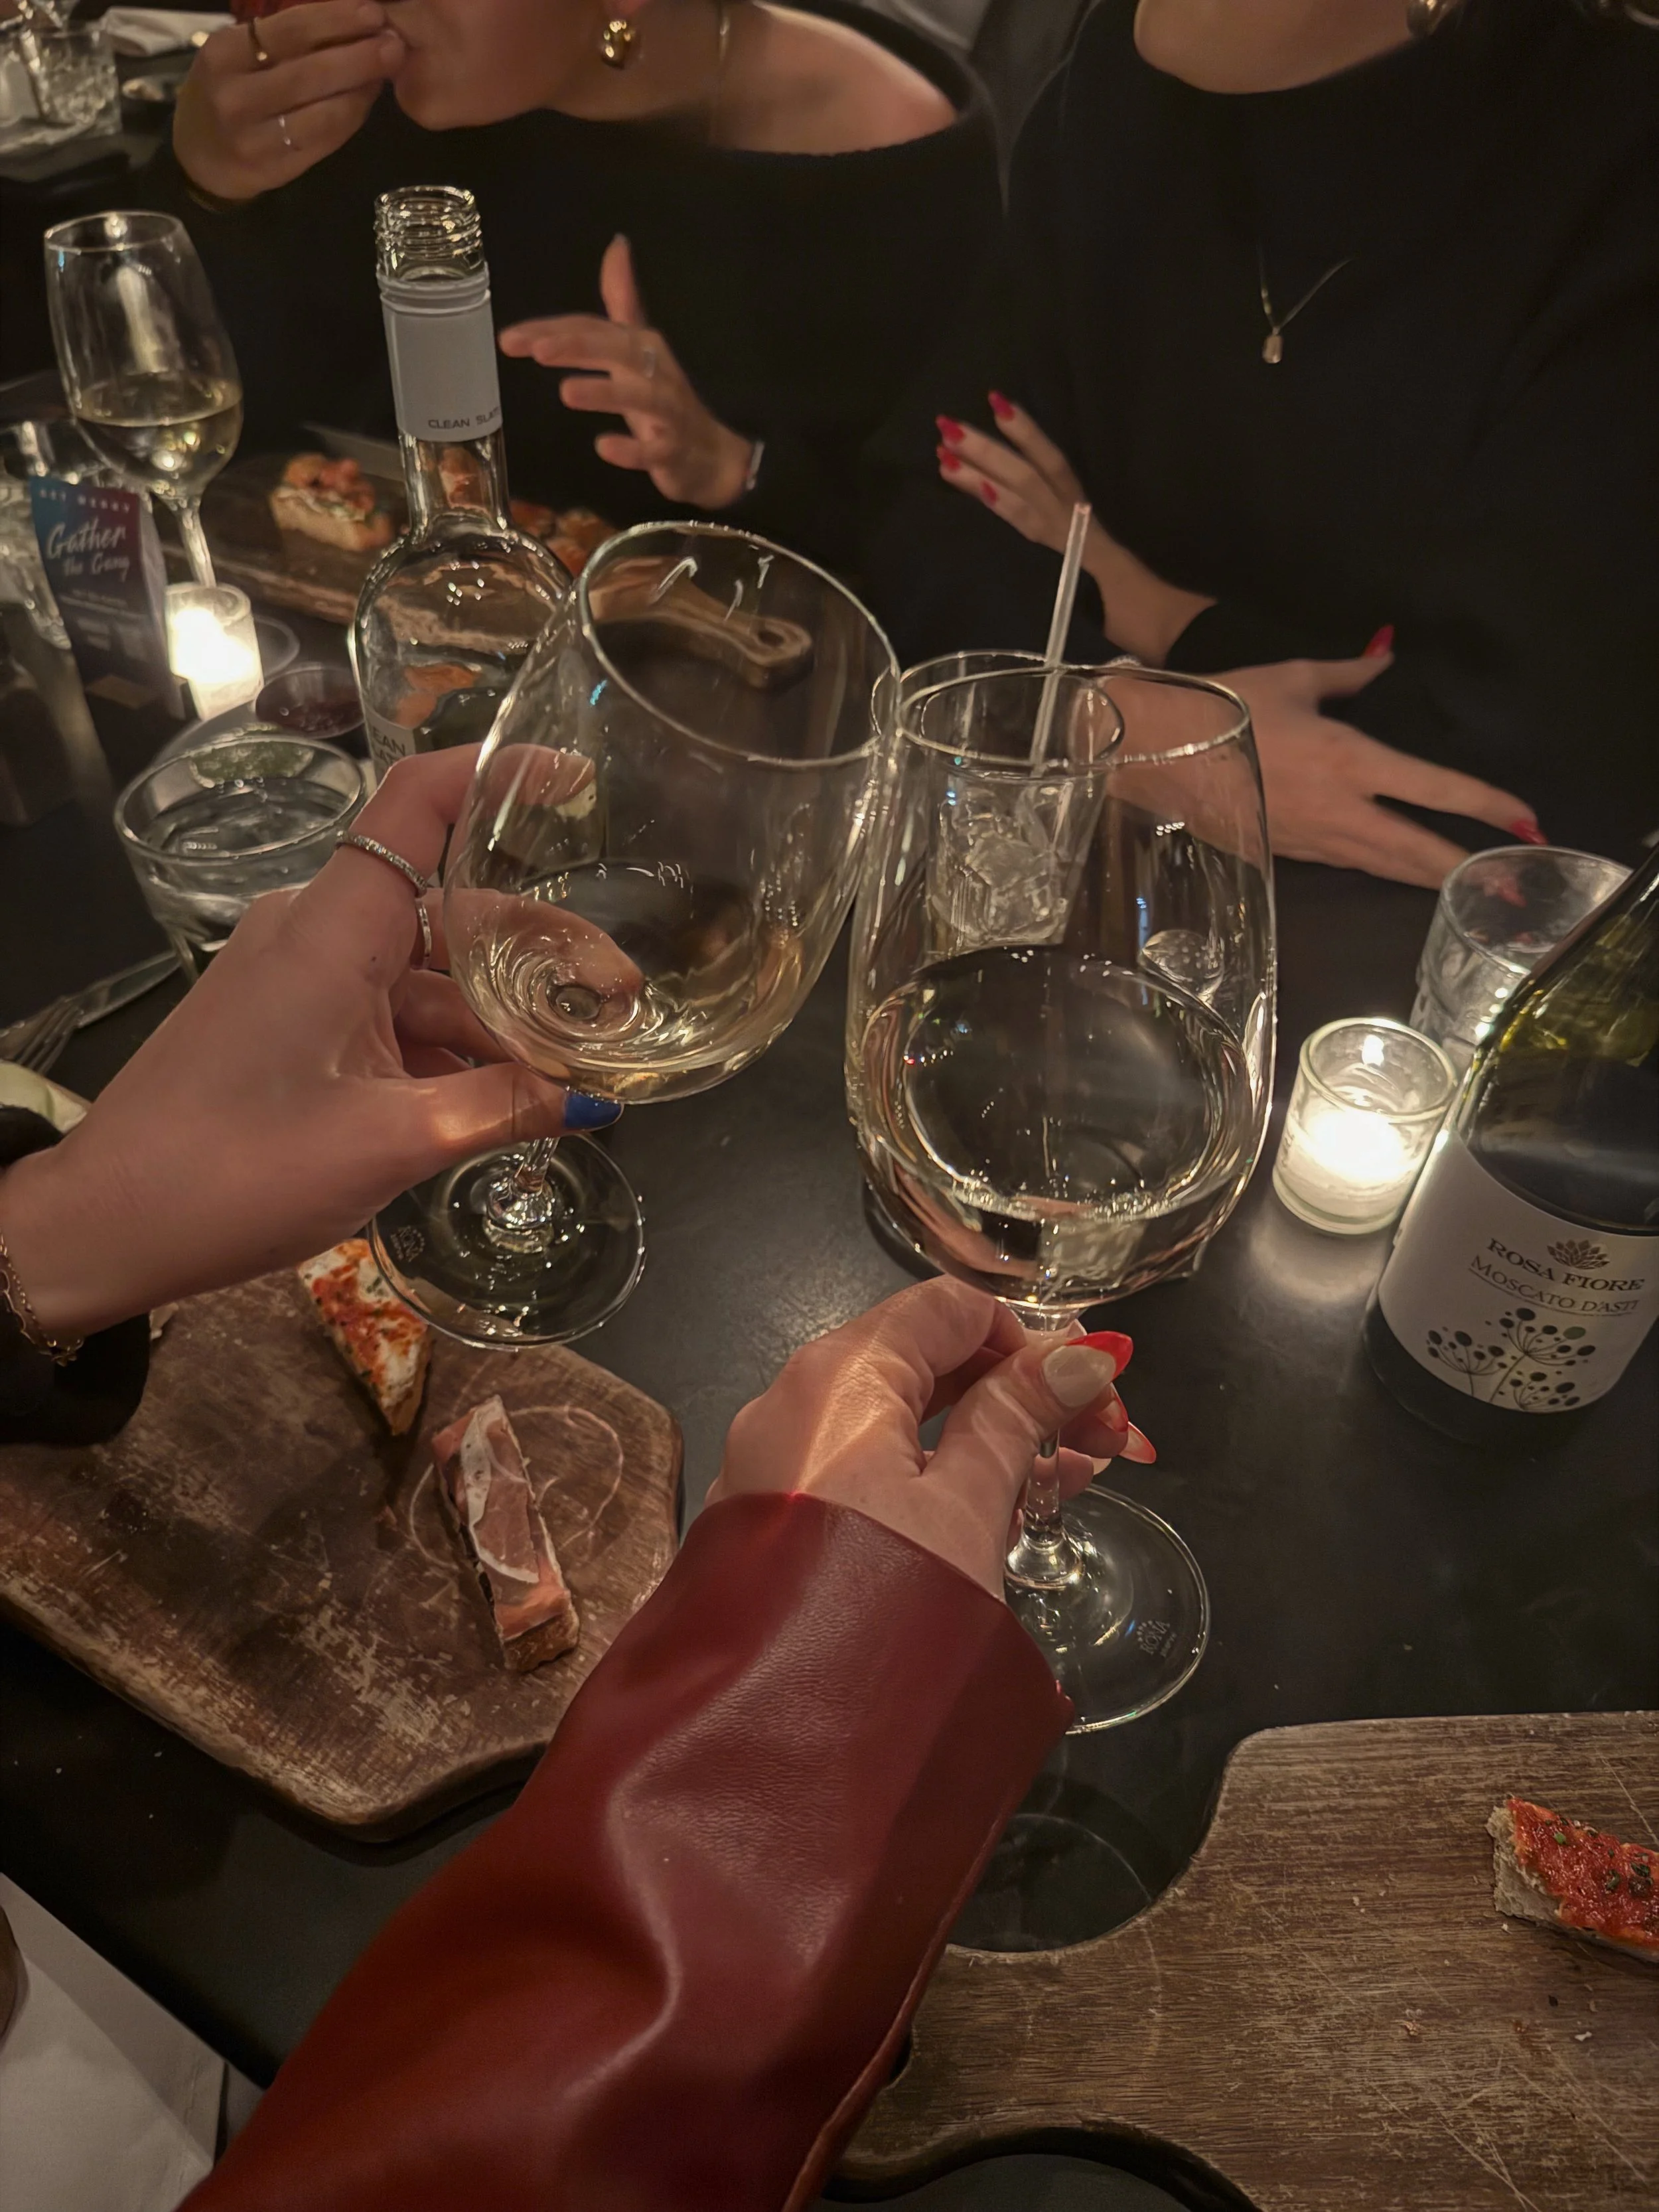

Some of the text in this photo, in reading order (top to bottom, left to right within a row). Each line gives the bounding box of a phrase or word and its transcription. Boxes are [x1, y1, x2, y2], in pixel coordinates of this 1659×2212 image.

[428, 418, 470, 429] CLEAN
[46, 517, 127, 559] Gather
[91, 552, 130, 583] Gang
[373, 725, 405, 757] EAN
[1487, 1238, 1645, 1291] ROSA FIORE
[1471, 1254, 1641, 1313] MOSCATO D'ASTI
